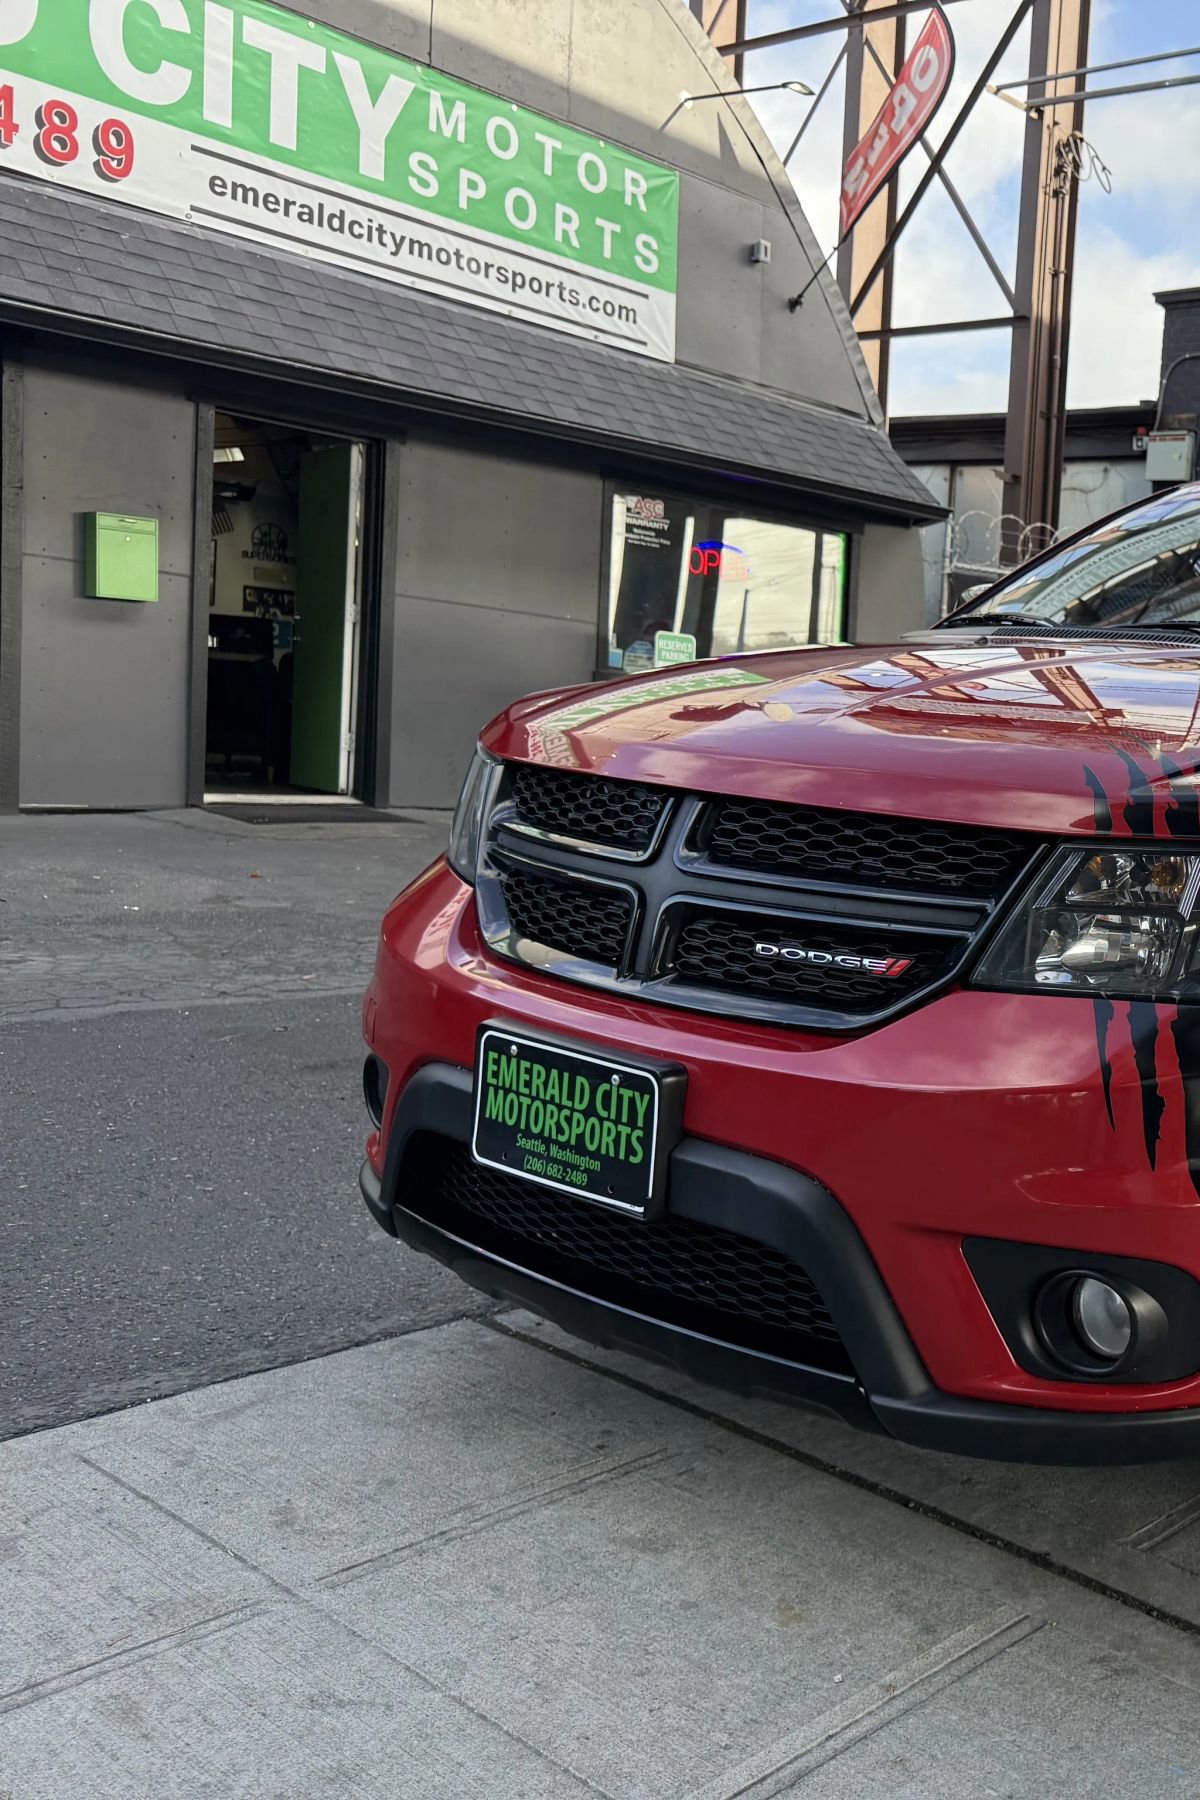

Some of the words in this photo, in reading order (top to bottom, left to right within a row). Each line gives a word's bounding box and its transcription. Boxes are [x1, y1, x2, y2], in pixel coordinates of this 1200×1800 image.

[89, 0, 416, 182] CITY
[428, 89, 648, 213] MOTOR
[208, 174, 638, 325] emeraldcitymotorsports.com
[408, 151, 660, 274] SPORTS
[661, 650, 690, 662] PARKING
[755, 943, 888, 972] DODGE
[485, 1086, 645, 1164] MOTORSPORTS
[486, 1050, 590, 1111] EMERALD
[595, 1082, 650, 1128] CITY
[515, 1133, 549, 1157] Seattle,
[549, 1143, 601, 1172] Washington
[523, 1154, 547, 1176] (206)
[547, 1163, 588, 1187] 682-2489
